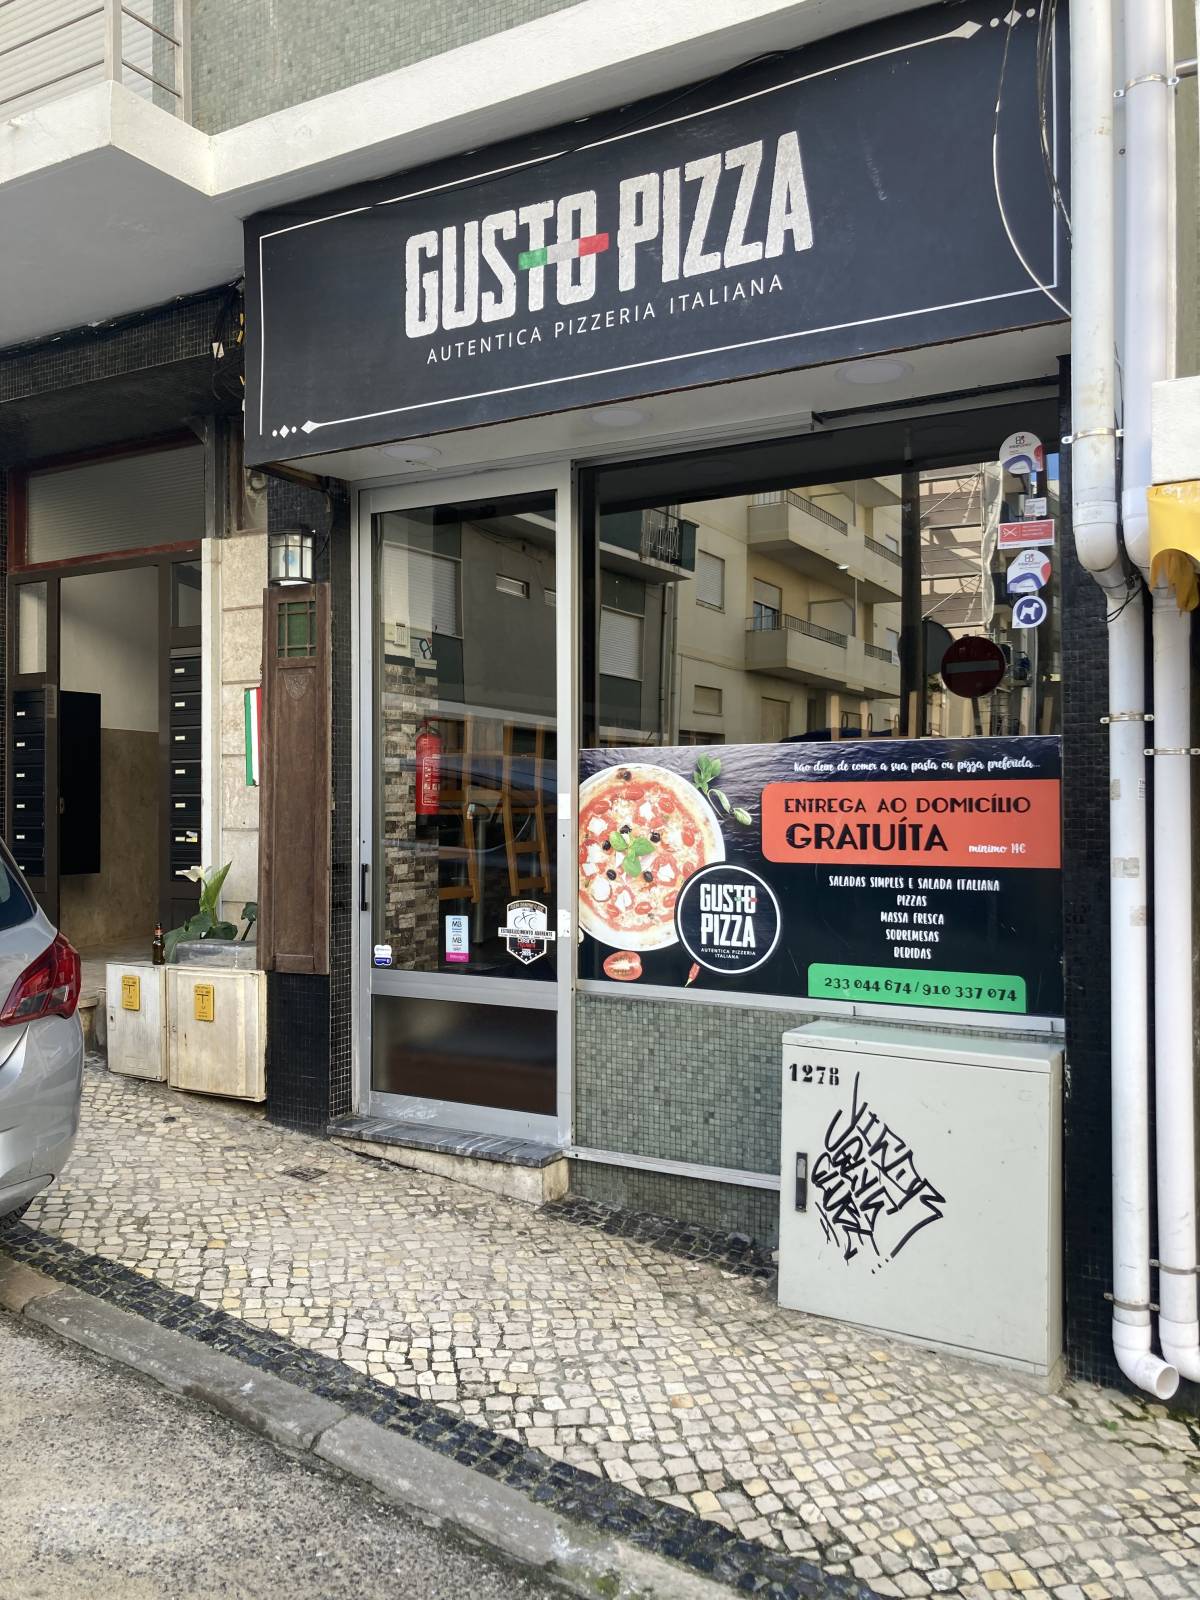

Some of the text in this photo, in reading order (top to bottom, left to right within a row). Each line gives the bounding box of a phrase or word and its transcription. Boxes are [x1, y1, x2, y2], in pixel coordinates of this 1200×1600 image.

[405, 131, 813, 339] GUSTO PIZZA
[427, 274, 783, 365] AUTENTICA PIZZERIA ITALIANA
[837, 760, 849, 771] de
[852, 762, 877, 771] comer
[880, 762, 888, 771] a
[891, 762, 908, 771] sua
[911, 759, 938, 773] pasta
[941, 761, 954, 770] ou
[957, 760, 985, 772] pizza
[784, 793, 1031, 814] ENTREGA AO DOMICÍLIO
[785, 817, 949, 851] GRATUÍTA
[829, 875, 1000, 892] SALADAS SIMPLES E SALADA ITALIANA
[700, 883, 757, 914] GUSTO
[897, 894, 927, 907] PIZZAS
[880, 911, 944, 925] MASSA FRESCA
[701, 912, 756, 948] PIZZA
[885, 929, 940, 943] SOBREMESAS
[701, 947, 730, 955] AUTENTICA
[894, 946, 932, 960] BEBIDAS
[824, 977, 850, 990] 233
[854, 979, 881, 992] 044
[884, 979, 912, 994] 674
[922, 983, 951, 996] 910
[955, 985, 983, 1000] 337
[987, 988, 1017, 1002] 074
[789, 1063, 840, 1086] 1278
